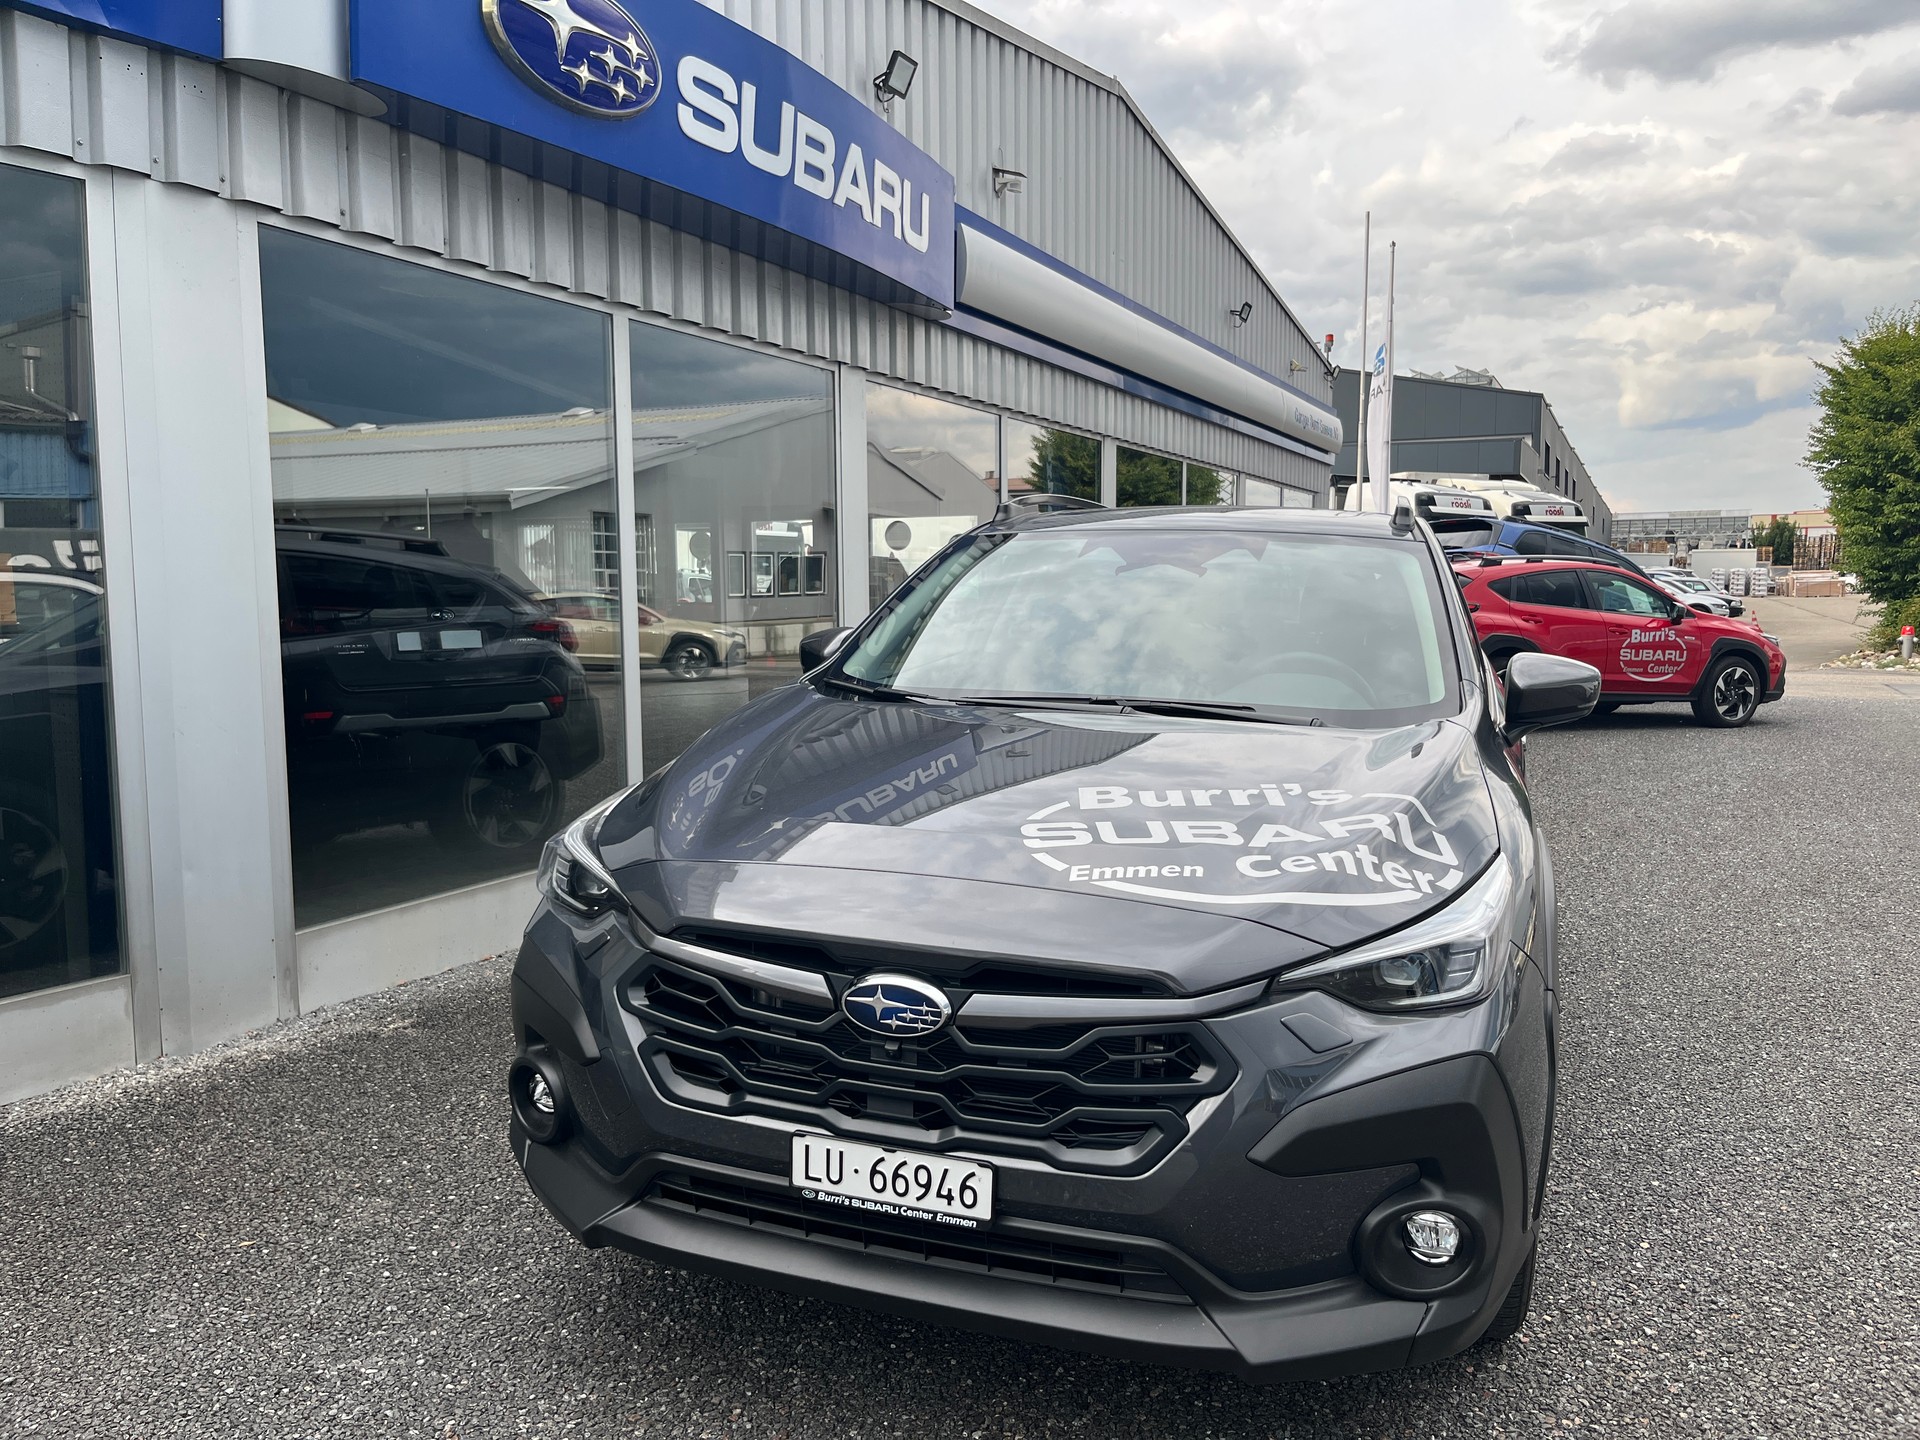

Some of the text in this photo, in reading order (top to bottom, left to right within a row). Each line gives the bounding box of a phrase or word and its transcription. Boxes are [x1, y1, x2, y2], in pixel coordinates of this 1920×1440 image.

[677, 55, 930, 253] SUBARU
[1631, 628, 1676, 643] Burri's
[1620, 648, 1687, 661] SUBARU
[1648, 663, 1678, 673] Center
[1078, 783, 1354, 810] Burri's
[1020, 812, 1459, 866] SUBARU
[1069, 863, 1204, 882] Emmen
[1235, 843, 1435, 894] Center
[817, 1191, 977, 1228] Burri's SUBARU Center Emmen
